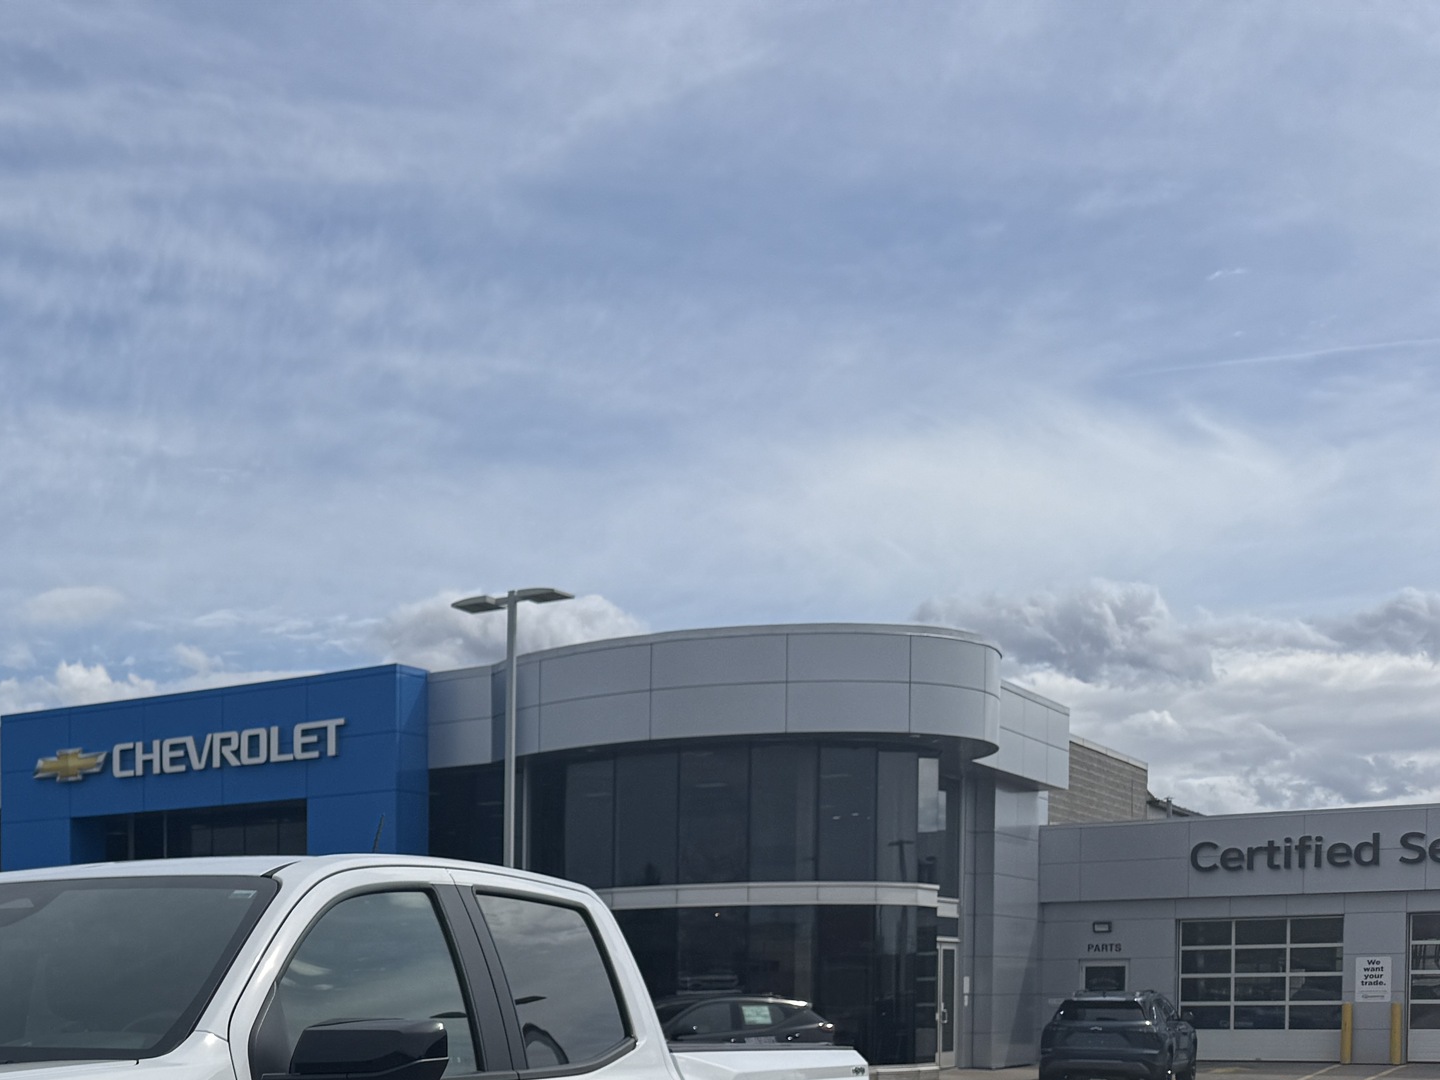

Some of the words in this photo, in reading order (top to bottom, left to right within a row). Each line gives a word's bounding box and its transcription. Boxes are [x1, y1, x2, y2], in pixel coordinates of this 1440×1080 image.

[112, 718, 345, 779] CHEVROLET
[1190, 832, 1381, 873] Certified
[1087, 943, 1122, 953] PARTS
